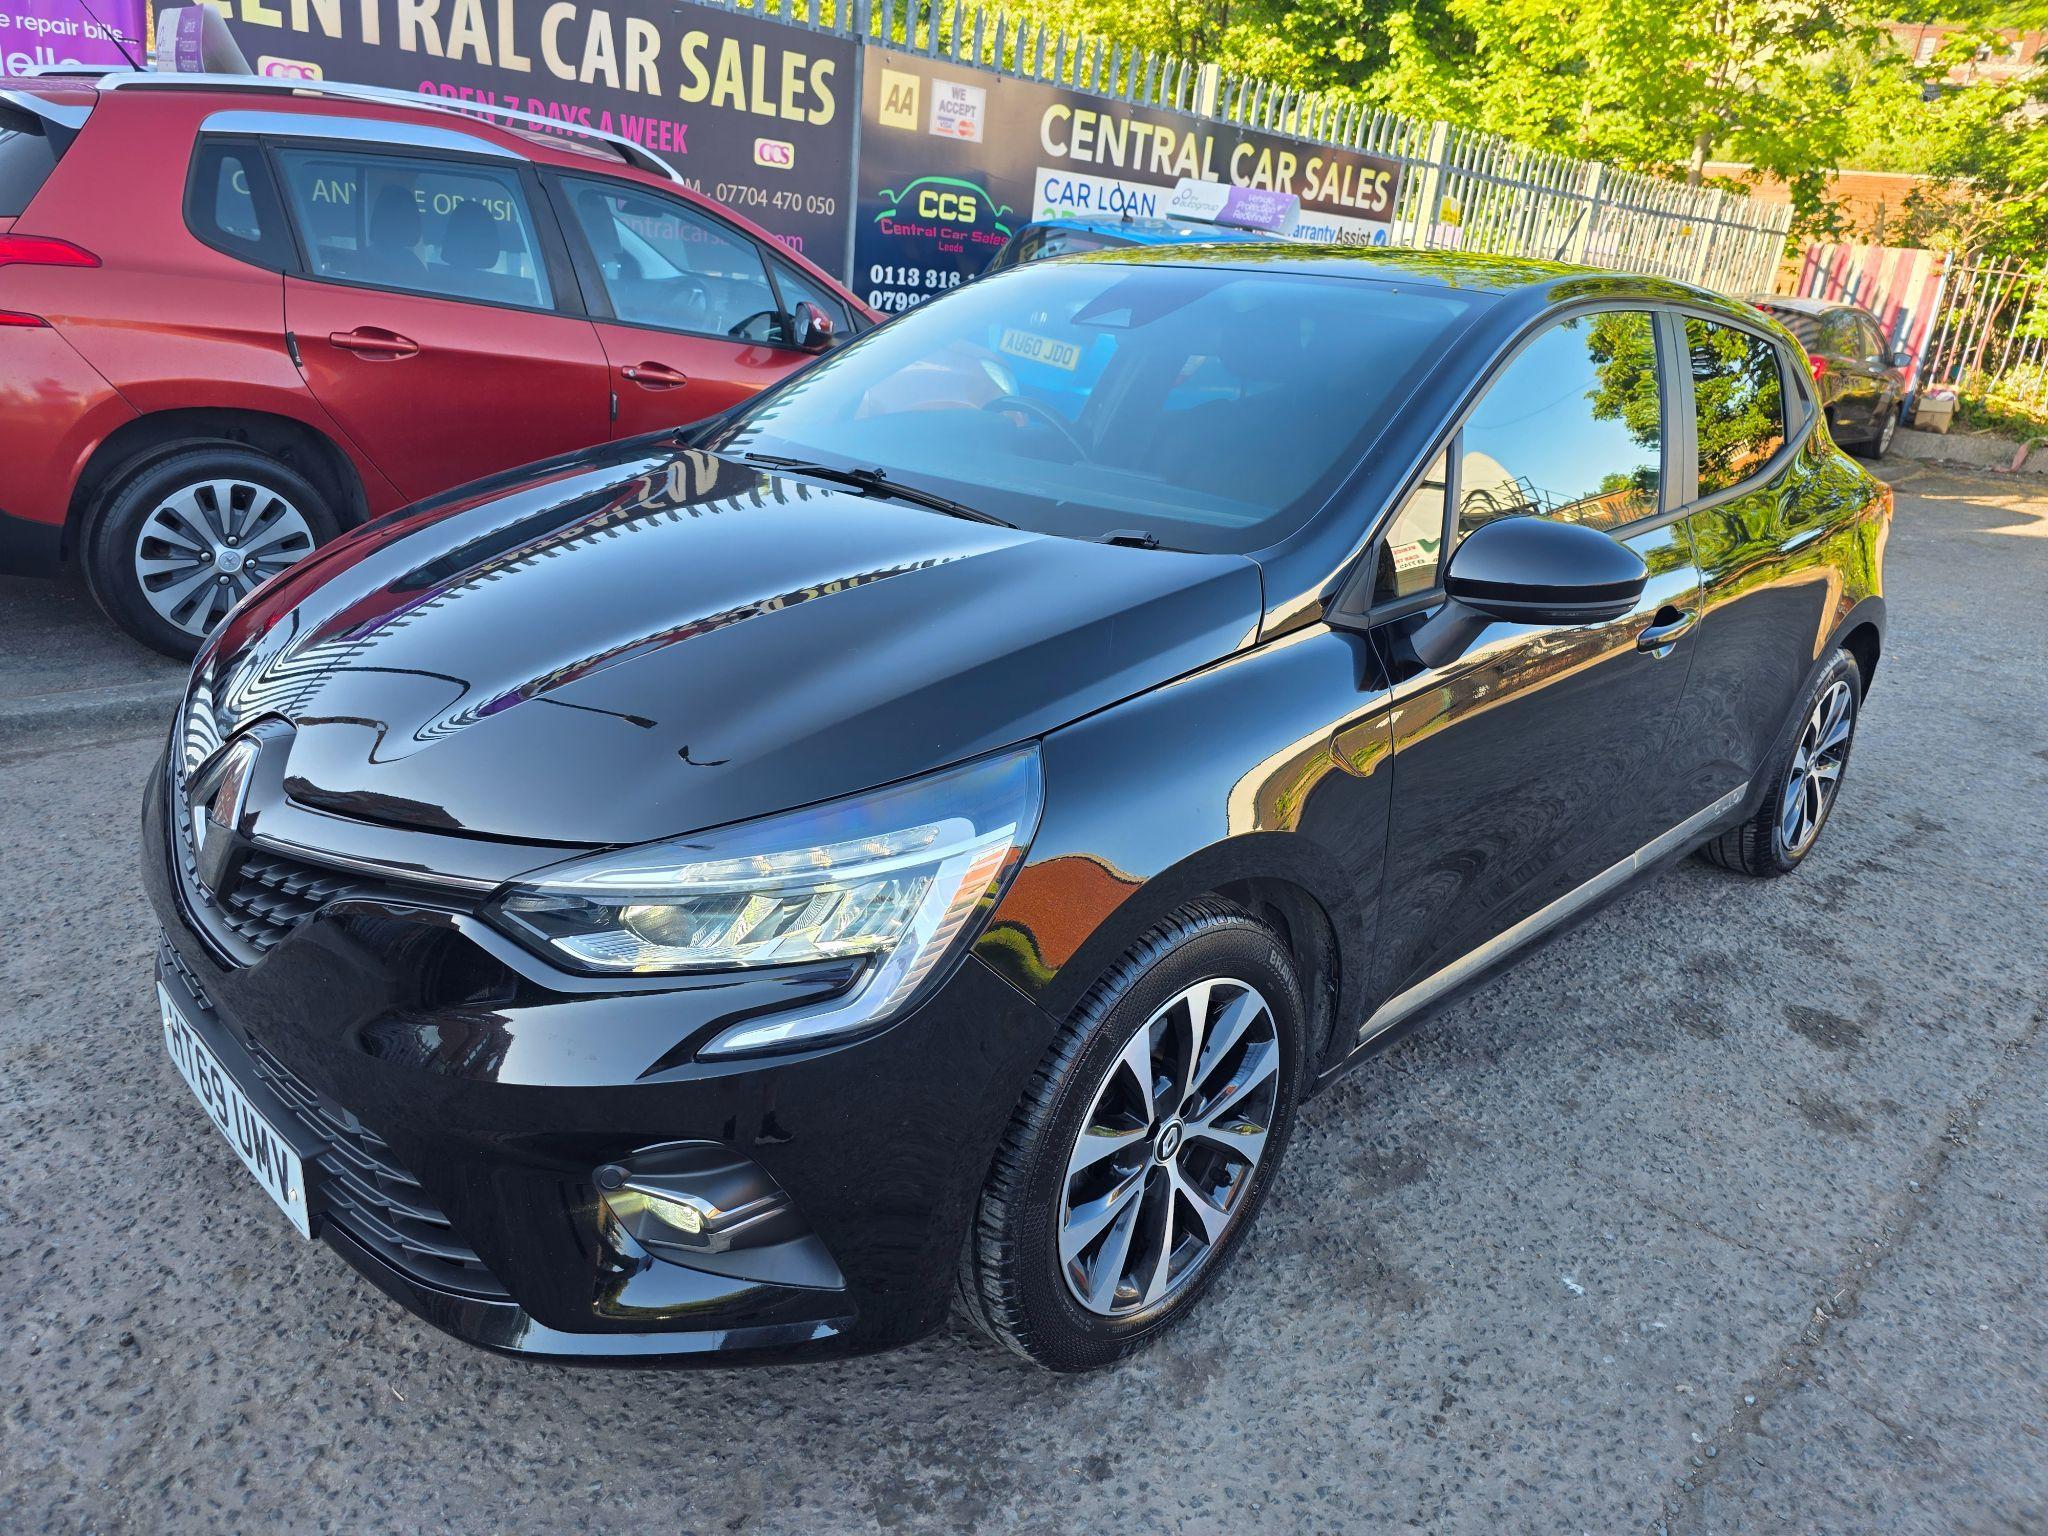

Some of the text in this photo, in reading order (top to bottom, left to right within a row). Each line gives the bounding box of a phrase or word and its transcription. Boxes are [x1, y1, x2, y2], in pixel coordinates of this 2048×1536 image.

[15, 15, 79, 37] repair
[540, 2, 662, 96] CAR
[679, 31, 836, 126] SALES
[884, 83, 914, 116] AA
[939, 100, 977, 118] ACCEPT
[952, 86, 968, 102] WE
[503, 96, 520, 127] 7
[528, 98, 593, 139] DAYS
[599, 111, 614, 141] A
[614, 113, 688, 154] WEEK
[1040, 103, 1391, 213] CENTRAL CAR SALES
[717, 183, 768, 207] 07704
[772, 192, 802, 211] 470
[806, 195, 835, 216] 050
[918, 190, 977, 223] CCS
[1044, 177, 1092, 208] CAR
[1098, 185, 1156, 217] LOAN
[880, 218, 1009, 246] Central Car Sales
[1288, 223, 1371, 246] arrantyAssist
[870, 264, 961, 289] 0113 318
[168, 1002, 290, 1205] HT69 UMV
